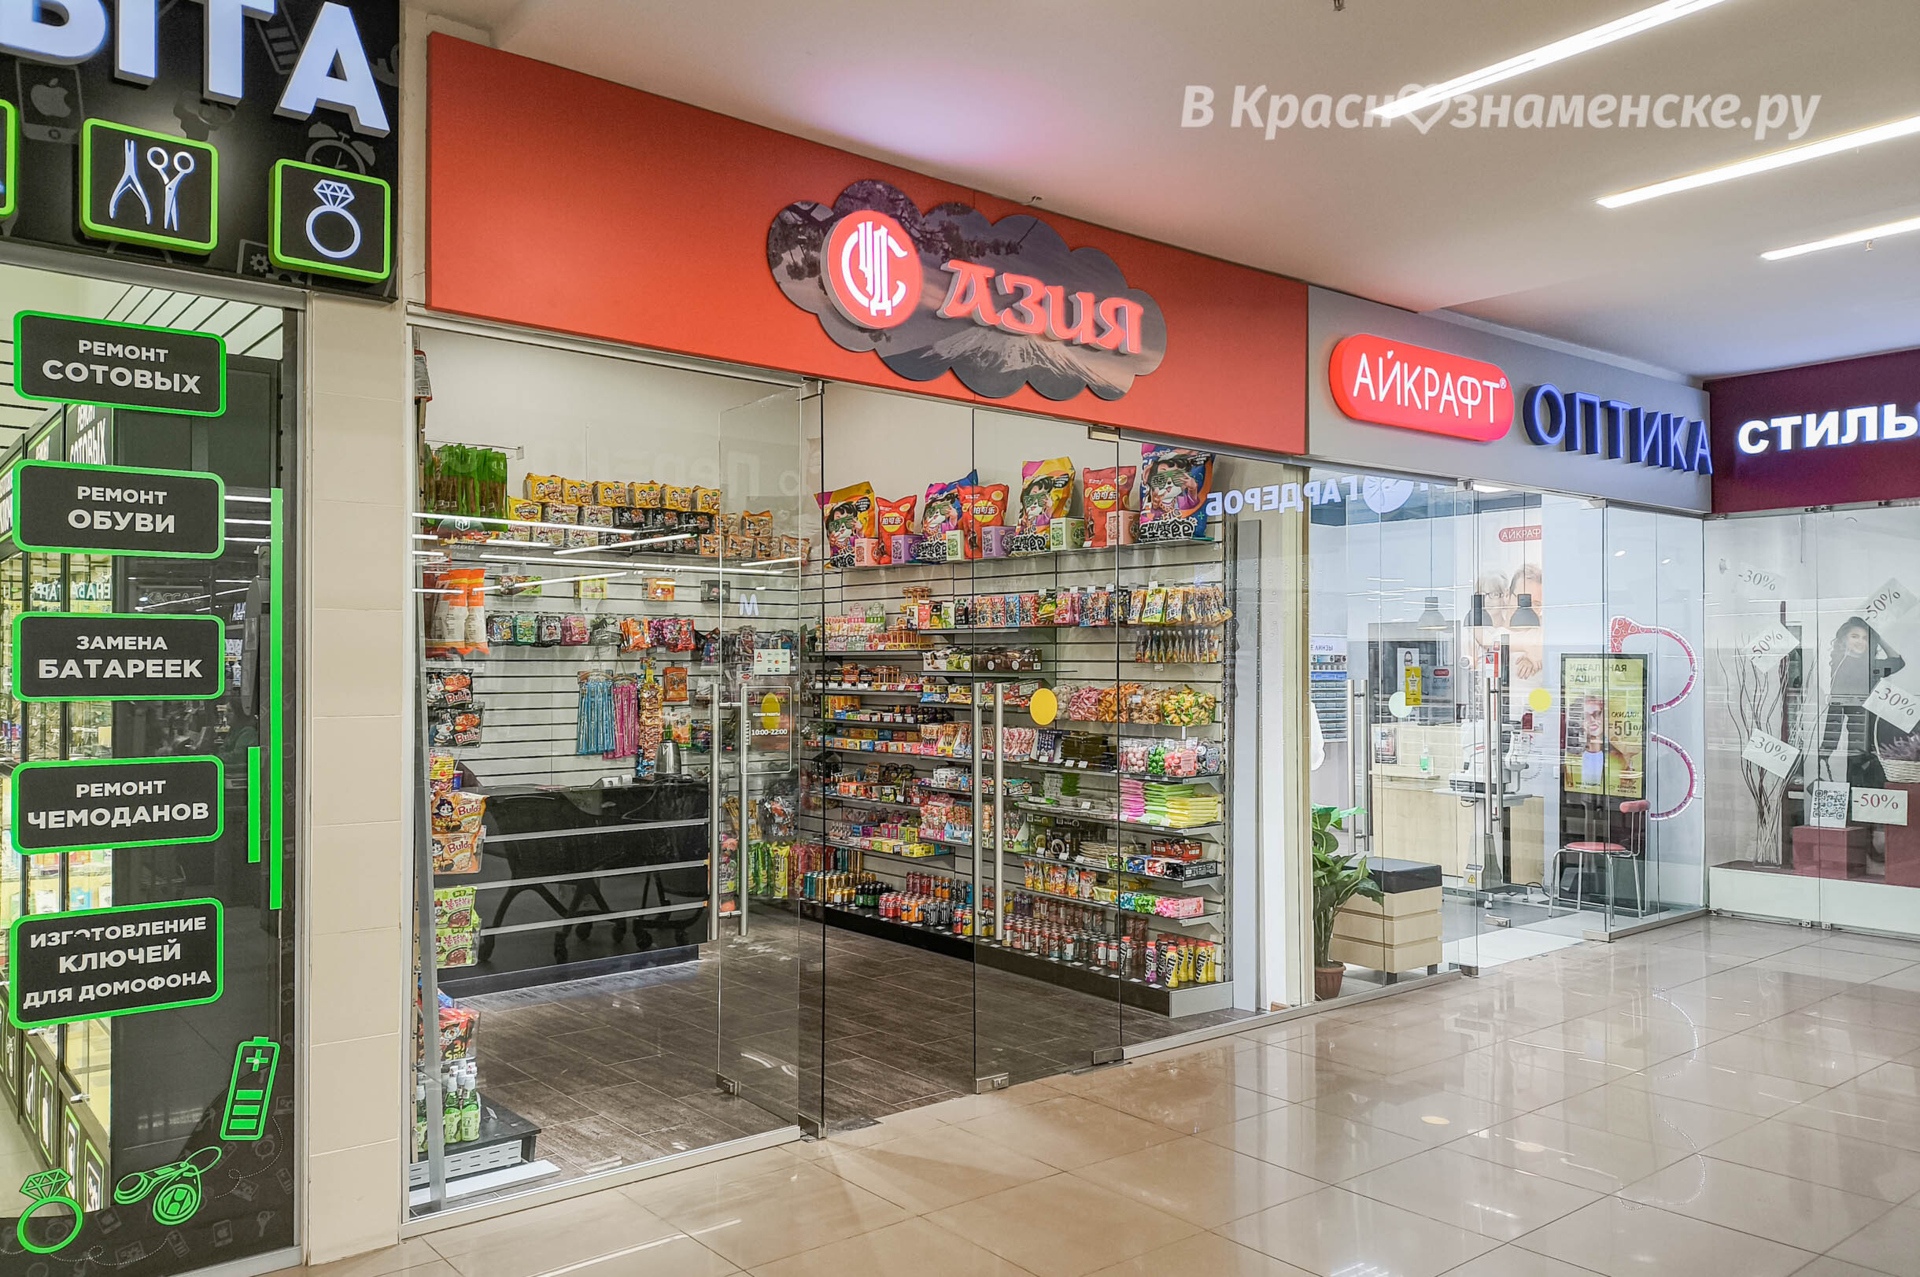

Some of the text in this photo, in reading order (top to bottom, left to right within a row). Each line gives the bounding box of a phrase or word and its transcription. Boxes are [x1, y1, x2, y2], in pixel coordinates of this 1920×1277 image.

[78, 339, 169, 363] РЕМОНТ
[42, 359, 201, 395] СОТОВЫХ
[1523, 382, 1714, 476] ОПТИКА
[77, 485, 168, 505] РЕМОНТ
[67, 508, 175, 534] ОБУВИ
[1738, 569, 1776, 591] -30%
[1864, 587, 1901, 622] -50%
[76, 635, 168, 650] ЗАМЕНА
[1751, 629, 1783, 661] -50%
[38, 658, 203, 679] БАТАРЕЕК
[1569, 663, 1627, 672] ИДЕАЛНАЯ
[1874, 686, 1915, 717] -30%
[1750, 736, 1788, 763] -30%
[76, 780, 167, 798] РЕМОНТ
[1853, 792, 1899, 811] -50%
[27, 802, 210, 831] ЧЕМОДАНОВ
[58, 938, 181, 974] КЛЮЧЕЙ
[22, 970, 212, 1010] ДЛЯ ДОМОФОНА
